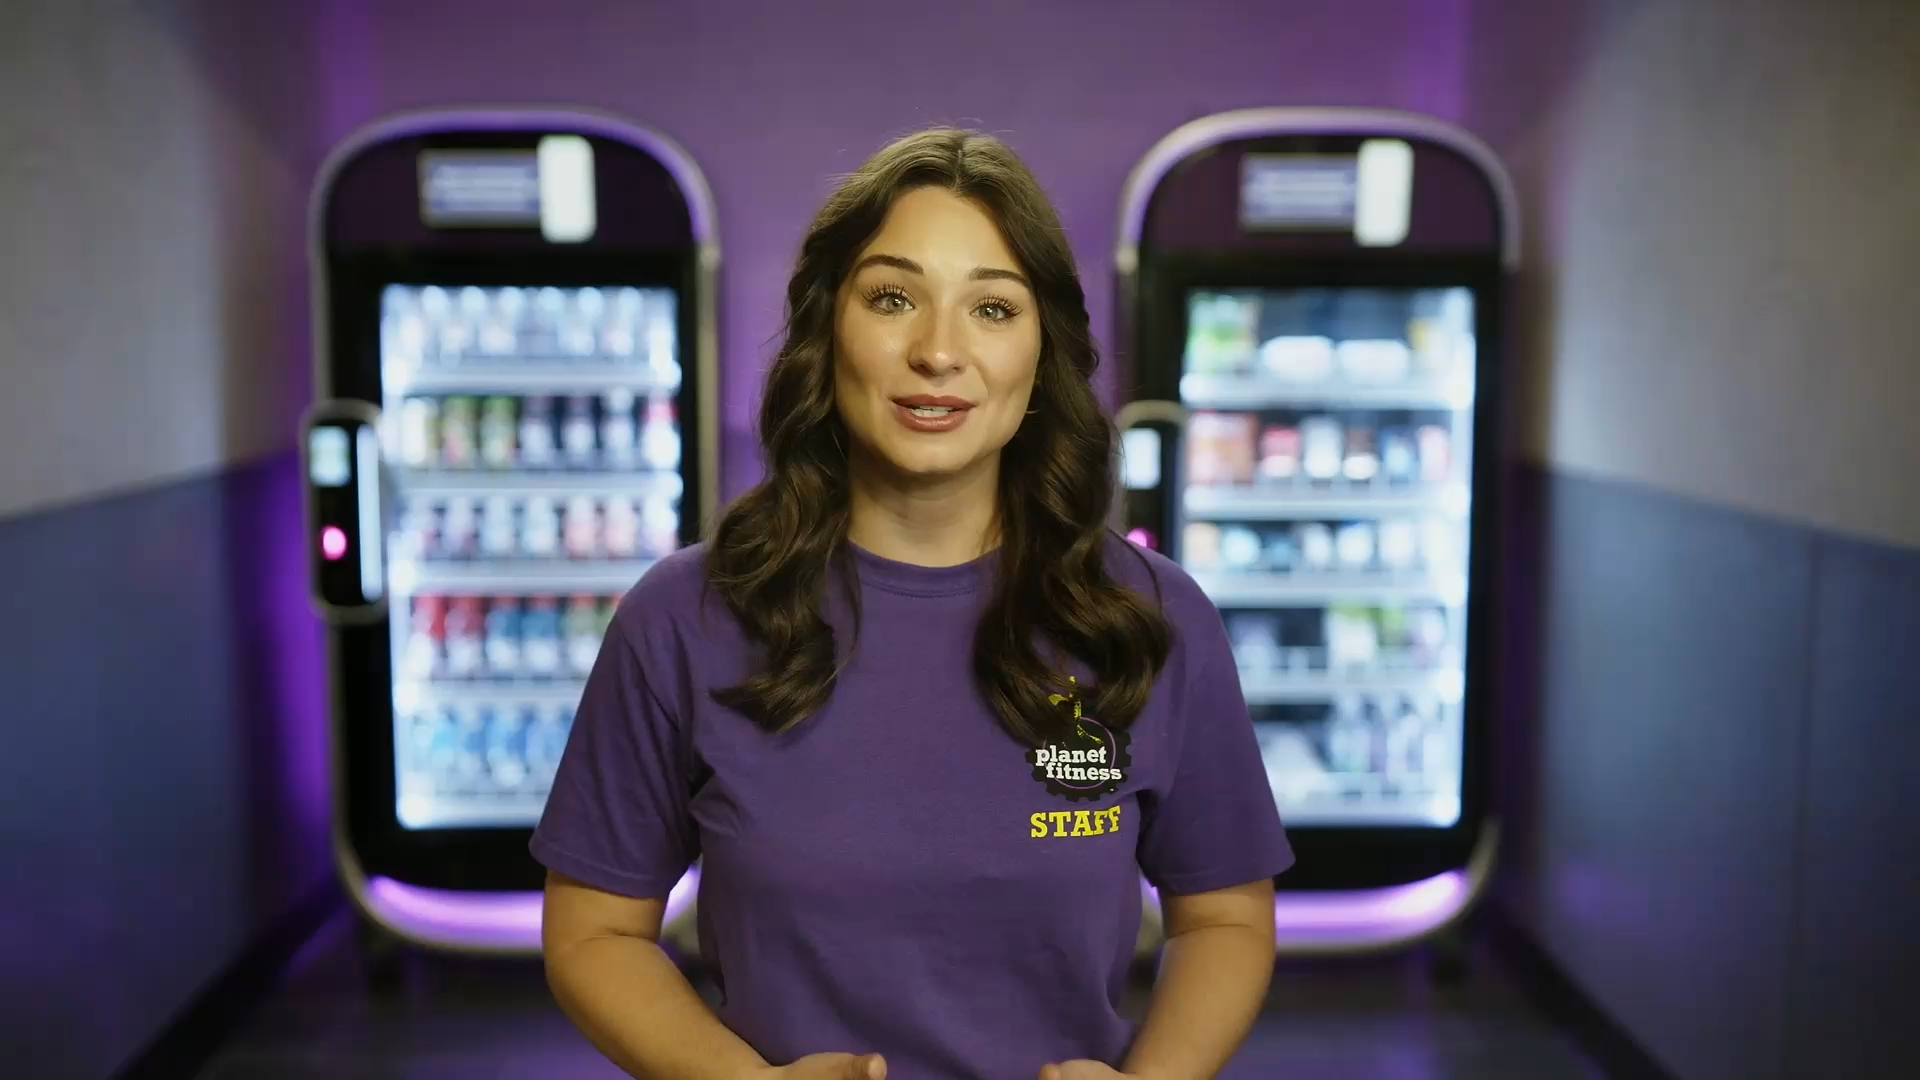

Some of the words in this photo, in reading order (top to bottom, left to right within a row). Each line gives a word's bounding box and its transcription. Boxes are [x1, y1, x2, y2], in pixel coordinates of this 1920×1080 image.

[1035, 745, 1107, 766] planet
[1046, 762, 1122, 780] fitness
[1030, 806, 1121, 838] STAFF
